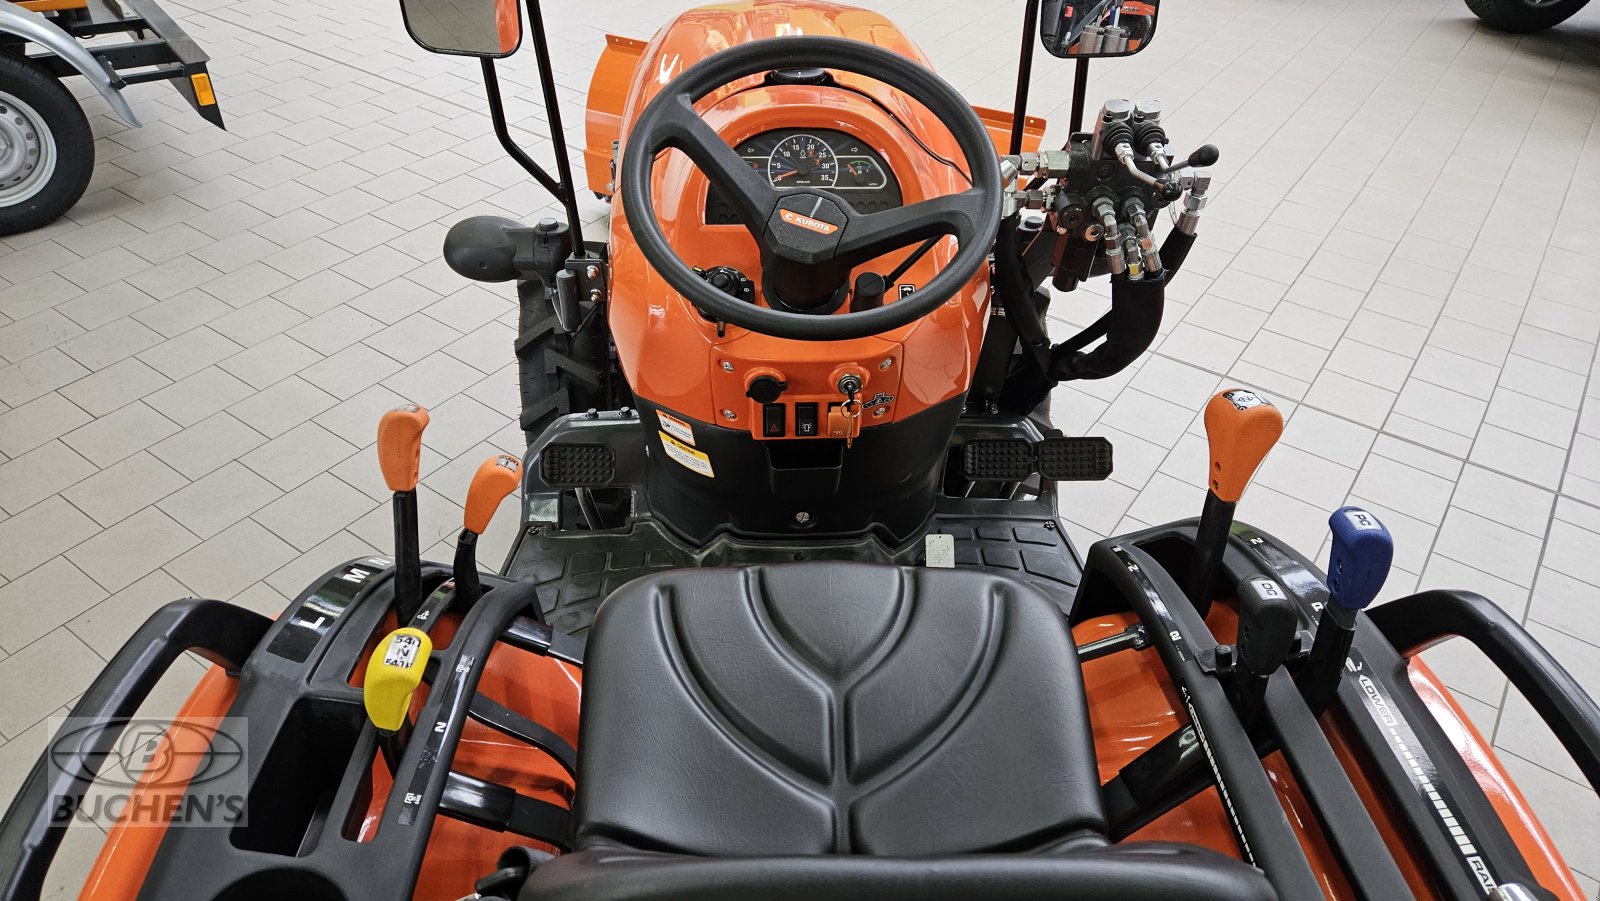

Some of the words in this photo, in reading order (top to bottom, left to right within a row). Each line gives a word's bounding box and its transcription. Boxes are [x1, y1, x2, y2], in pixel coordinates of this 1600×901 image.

[796, 216, 830, 232] KUBOTA
[1354, 514, 1372, 526] PC
[342, 567, 371, 584] M
[1261, 582, 1278, 596] DC
[298, 616, 326, 630] L
[396, 648, 410, 657] N
[1360, 678, 1394, 724] LOWER
[434, 721, 447, 733] N
